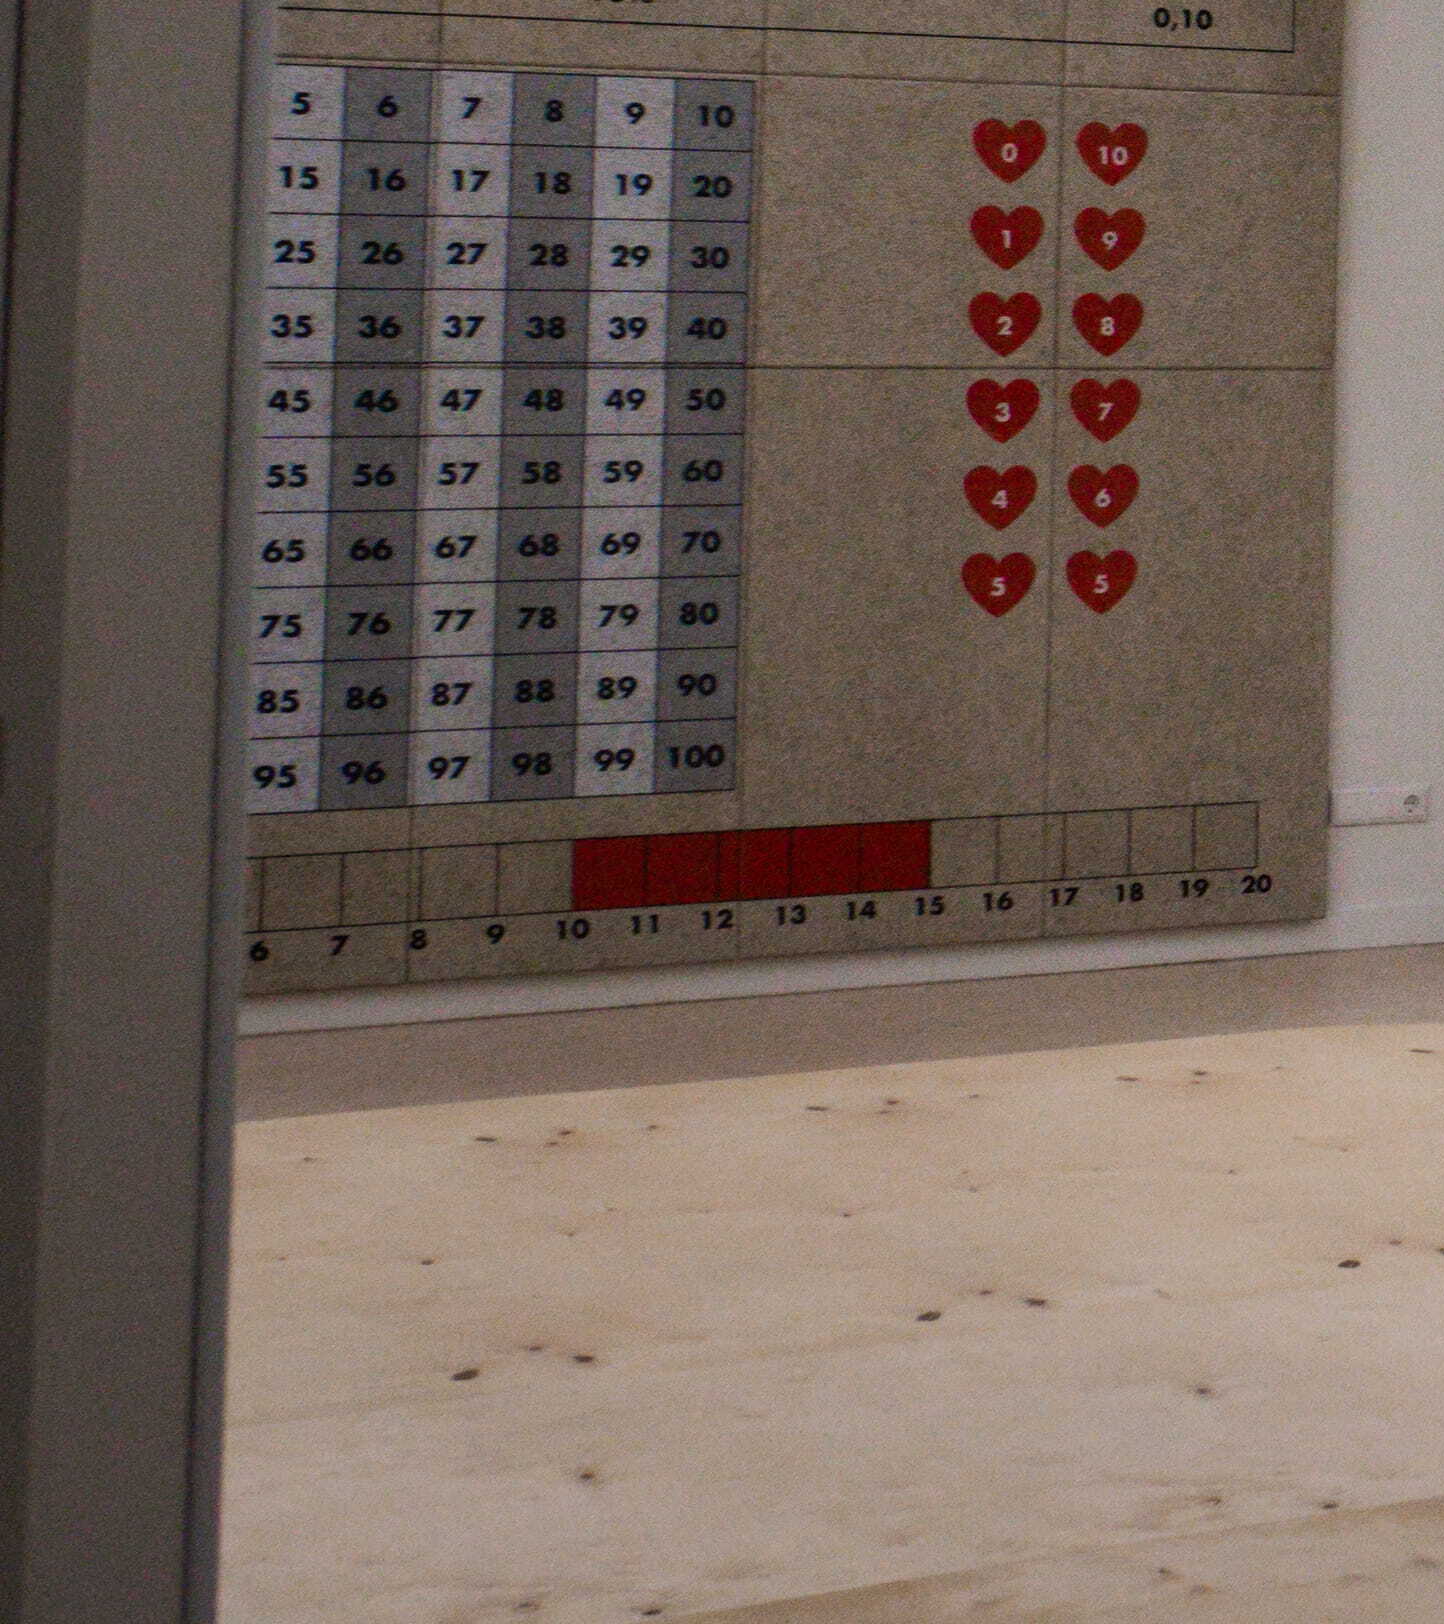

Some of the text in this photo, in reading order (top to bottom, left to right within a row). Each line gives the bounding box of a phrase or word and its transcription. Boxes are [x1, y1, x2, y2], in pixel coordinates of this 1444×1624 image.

[1153, 7, 1214, 31] 0,10
[291, 91, 735, 129] 5 6 7 8 9 10
[1000, 142, 1129, 166] 0 10
[280, 165, 733, 199] 15 16 17 18 19 20
[1001, 229, 1118, 250] 1 9
[274, 239, 730, 270] 25 26 27 28 29 30
[271, 314, 728, 341] 35 36 37 38 39 40
[997, 315, 1115, 337] 2 8
[268, 387, 727, 414] 45 46 47 48 49 50
[995, 401, 1113, 423] 3 7
[266, 459, 724, 489] 55 56 57 58 59 60
[991, 489, 1111, 509] 4 6
[261, 530, 722, 564] 65 66 67 68 69 70
[990, 573, 1109, 597] 5 5
[260, 601, 720, 639] 75 76 77 78 79 80
[256, 673, 718, 714] 85 86 87 88 89 90
[253, 743, 726, 789] 95 96 97 98 99 100
[249, 873, 1273, 963] 6 7 8 9 10 11 12 13 14 15 16 17 18 19 20
